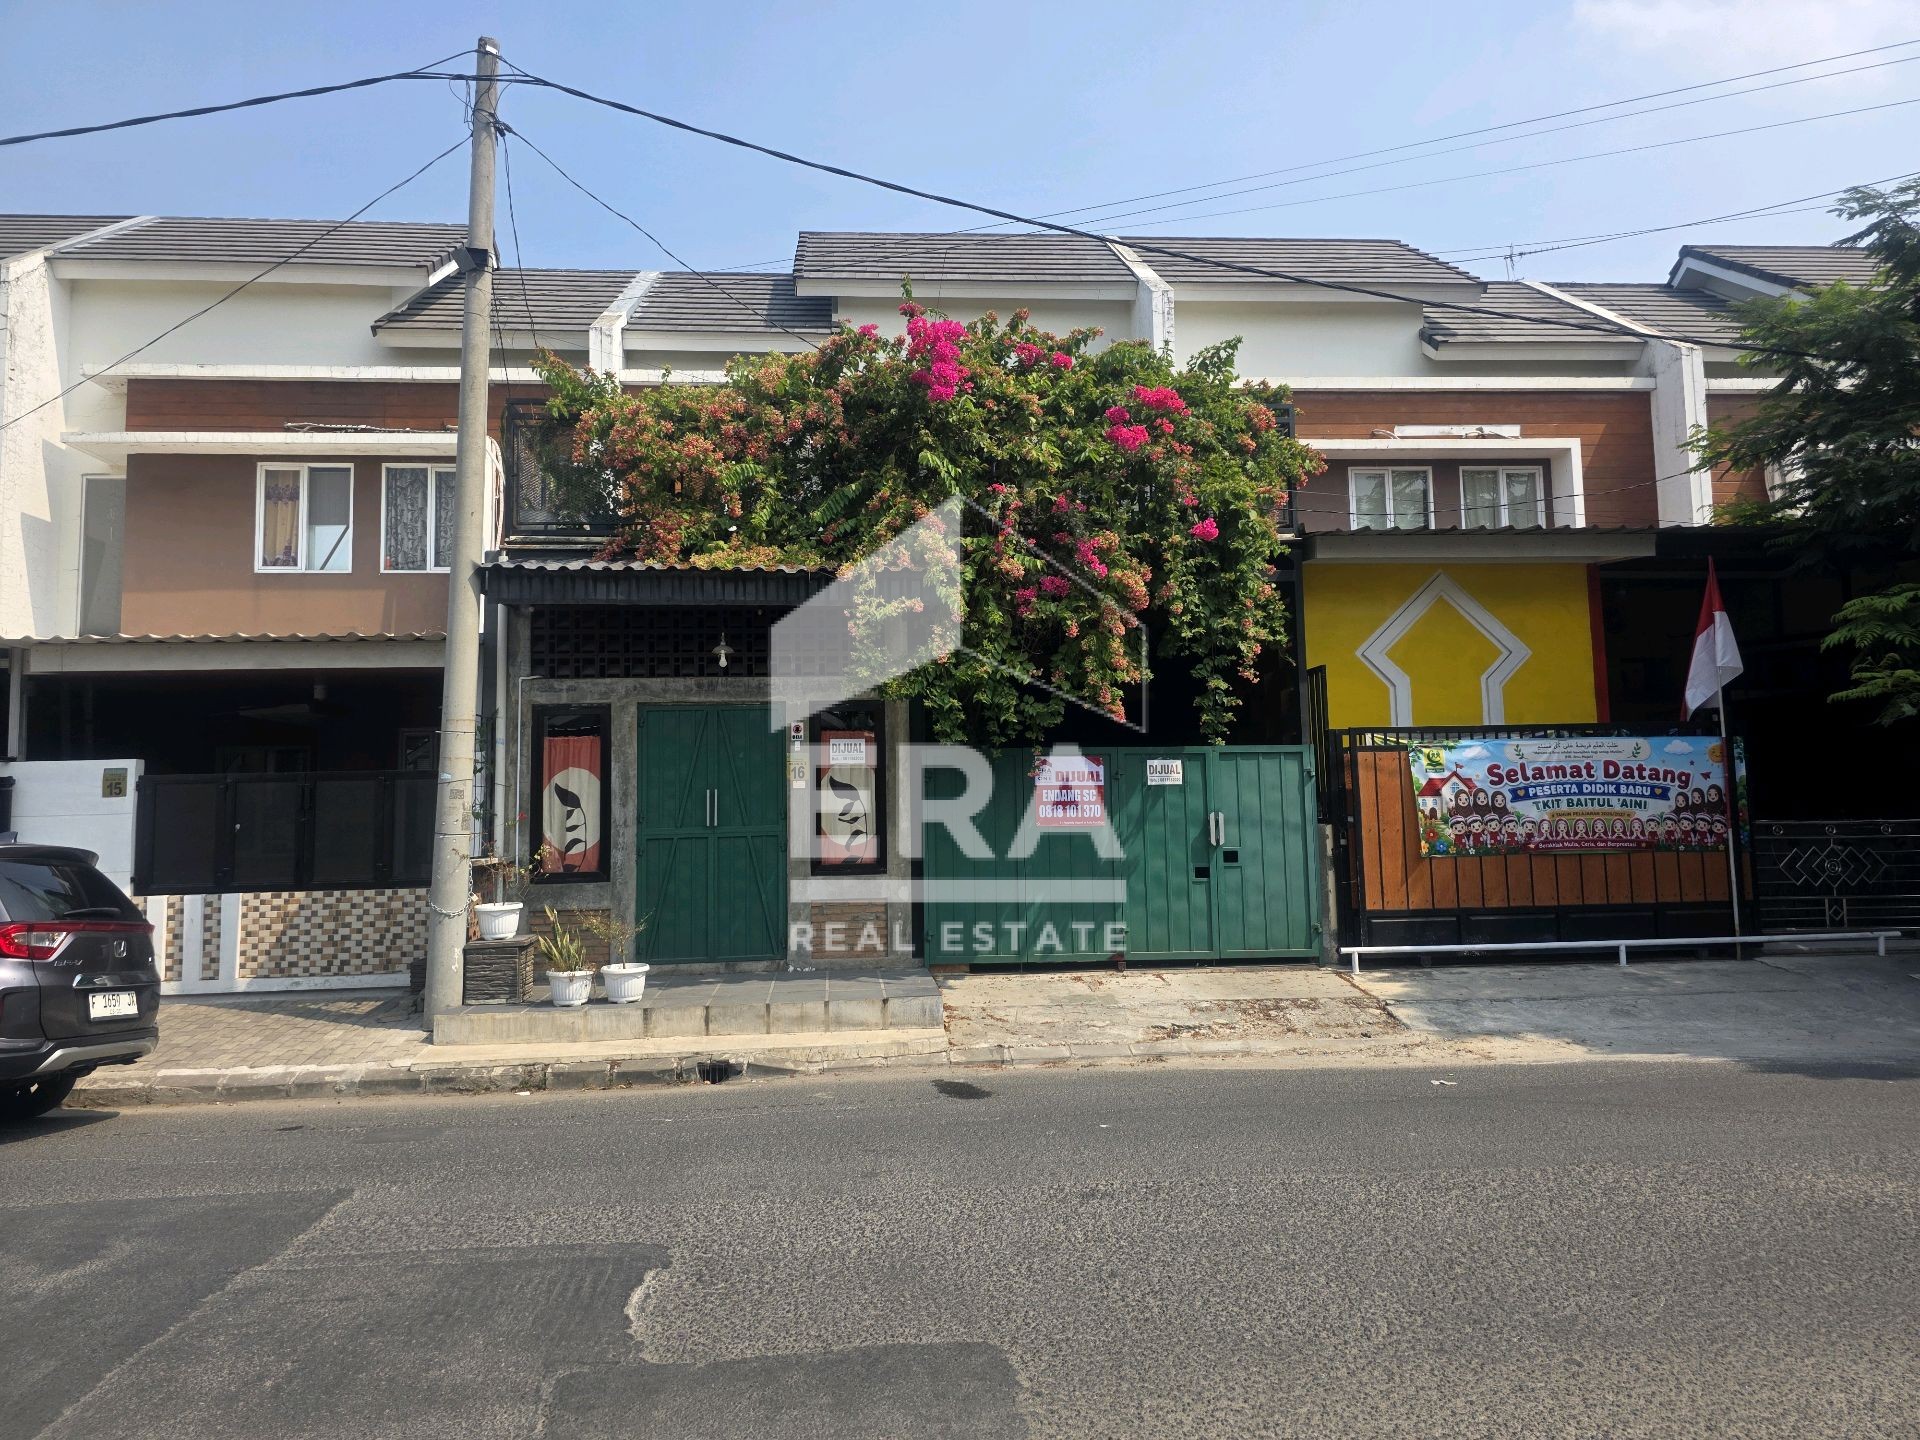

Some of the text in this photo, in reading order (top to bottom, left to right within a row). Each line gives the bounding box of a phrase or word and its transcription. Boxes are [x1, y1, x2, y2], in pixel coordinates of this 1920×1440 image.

[831, 742, 864, 754] DIJUAL
[791, 765, 805, 779] 16
[1055, 770, 1103, 783] DIJUAL
[1148, 764, 1181, 775] DIJUAL
[1486, 759, 1692, 790] Selamat Datang
[106, 781, 123, 796] 15
[1042, 789, 1097, 802] ENDANG SC
[1528, 783, 1651, 797] PESERTA DIDIK BARU
[1039, 804, 1064, 818] 0818
[1532, 798, 1562, 811] TKIT
[1566, 797, 1614, 808] BAITUL
[91, 994, 97, 1009] F
